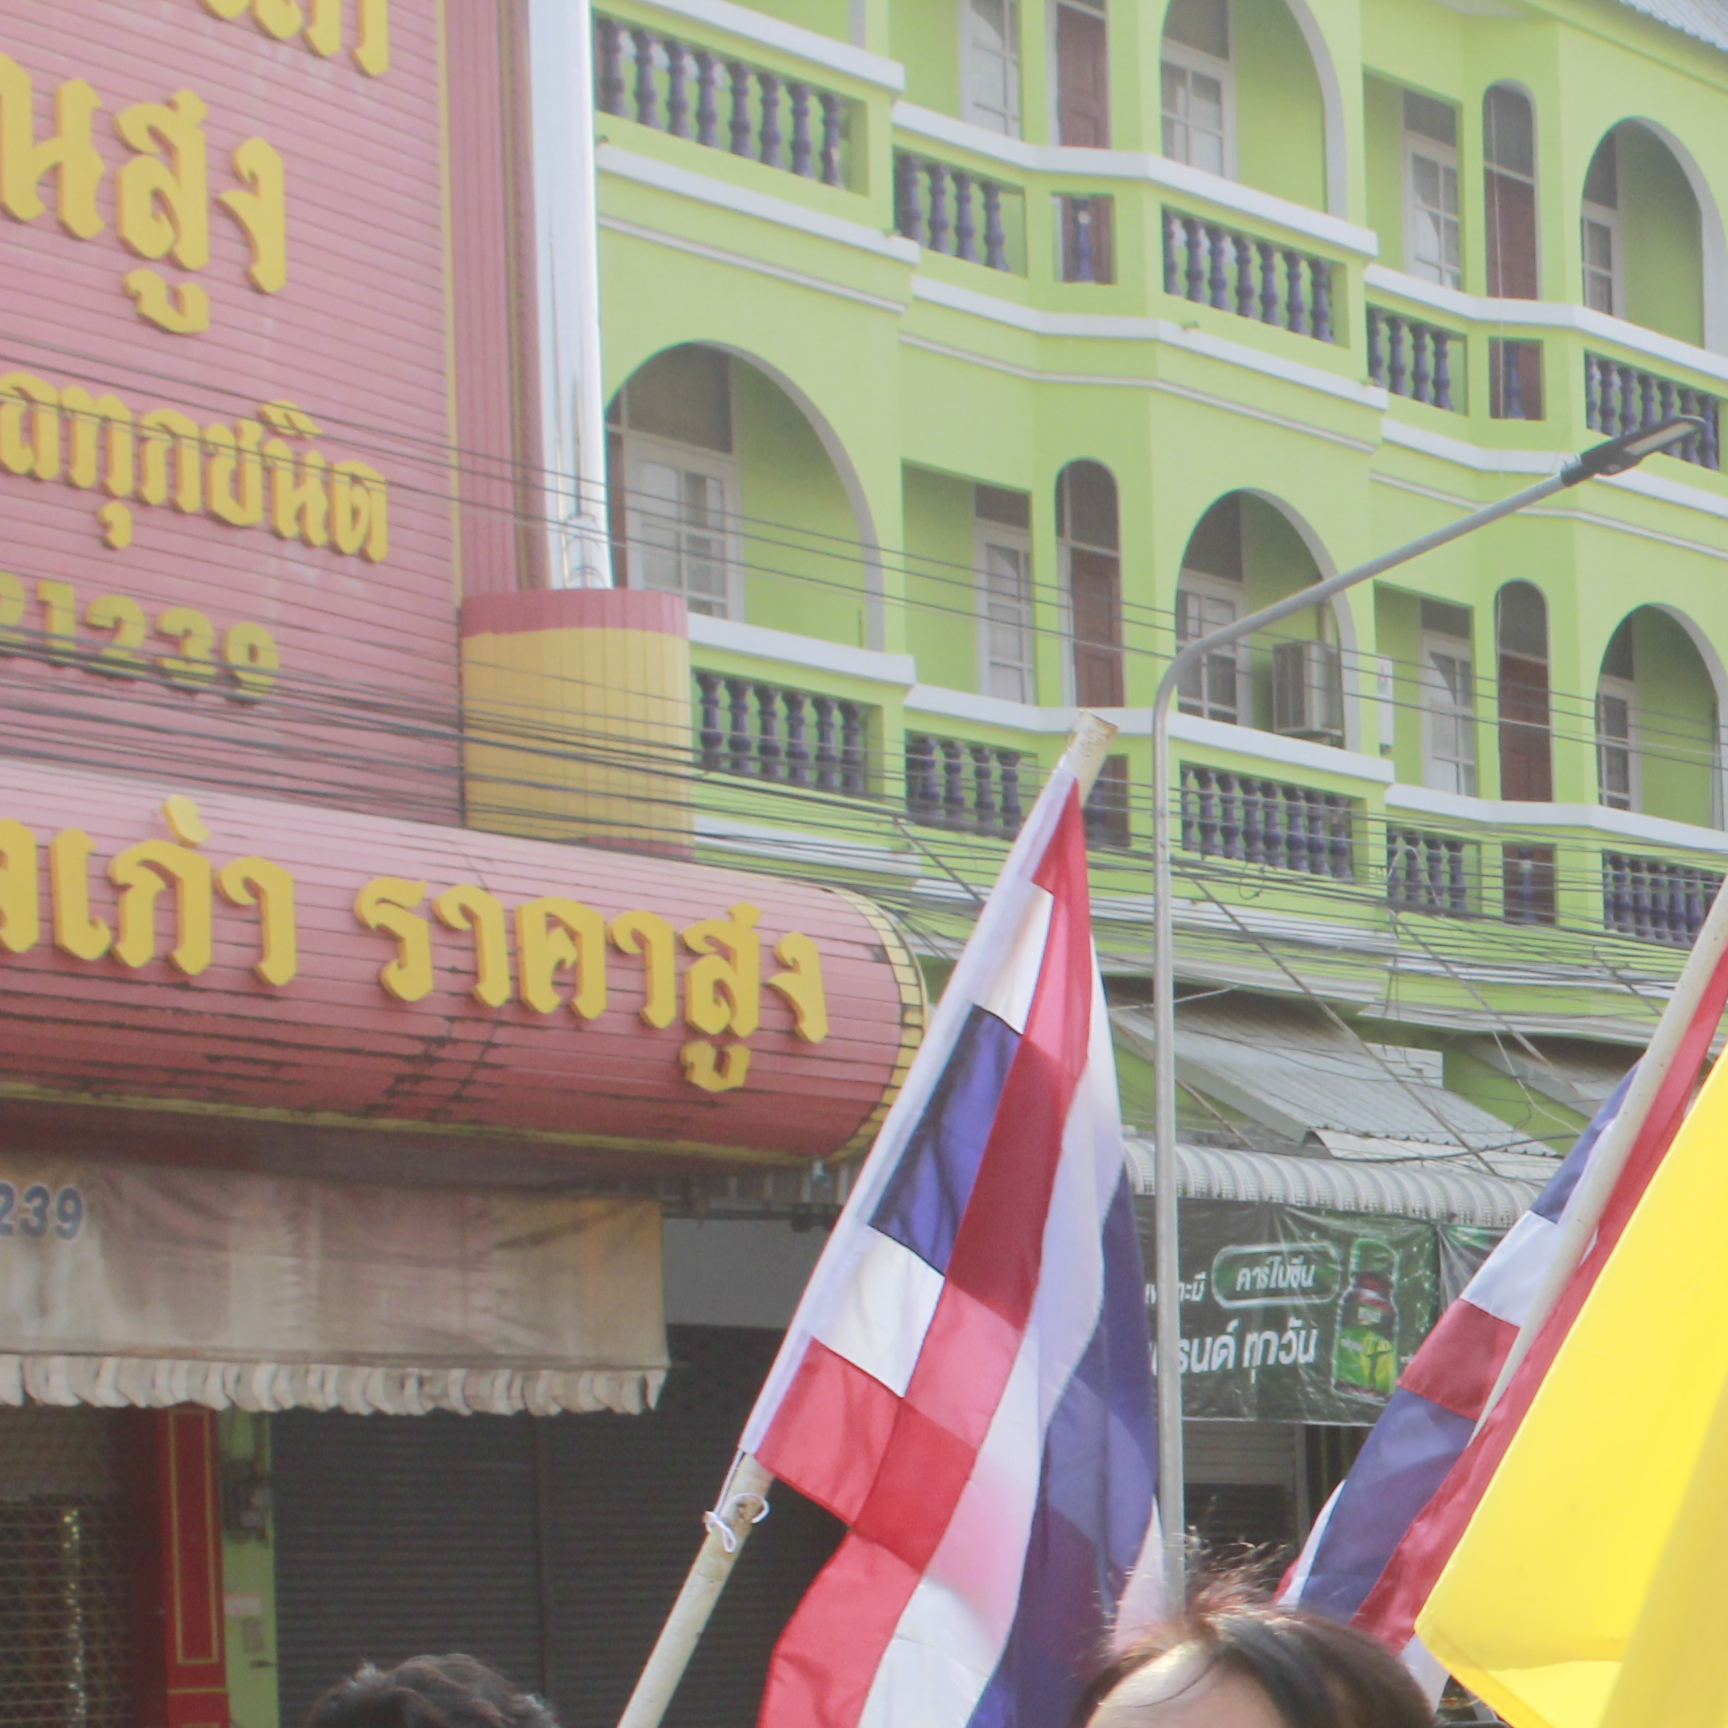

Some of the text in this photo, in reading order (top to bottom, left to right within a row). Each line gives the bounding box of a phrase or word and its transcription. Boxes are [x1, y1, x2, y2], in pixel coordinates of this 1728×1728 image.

[355, 876, 829, 1092] ราคาสูง
[1242, 1316, 1319, 1384] ทุกวัน
